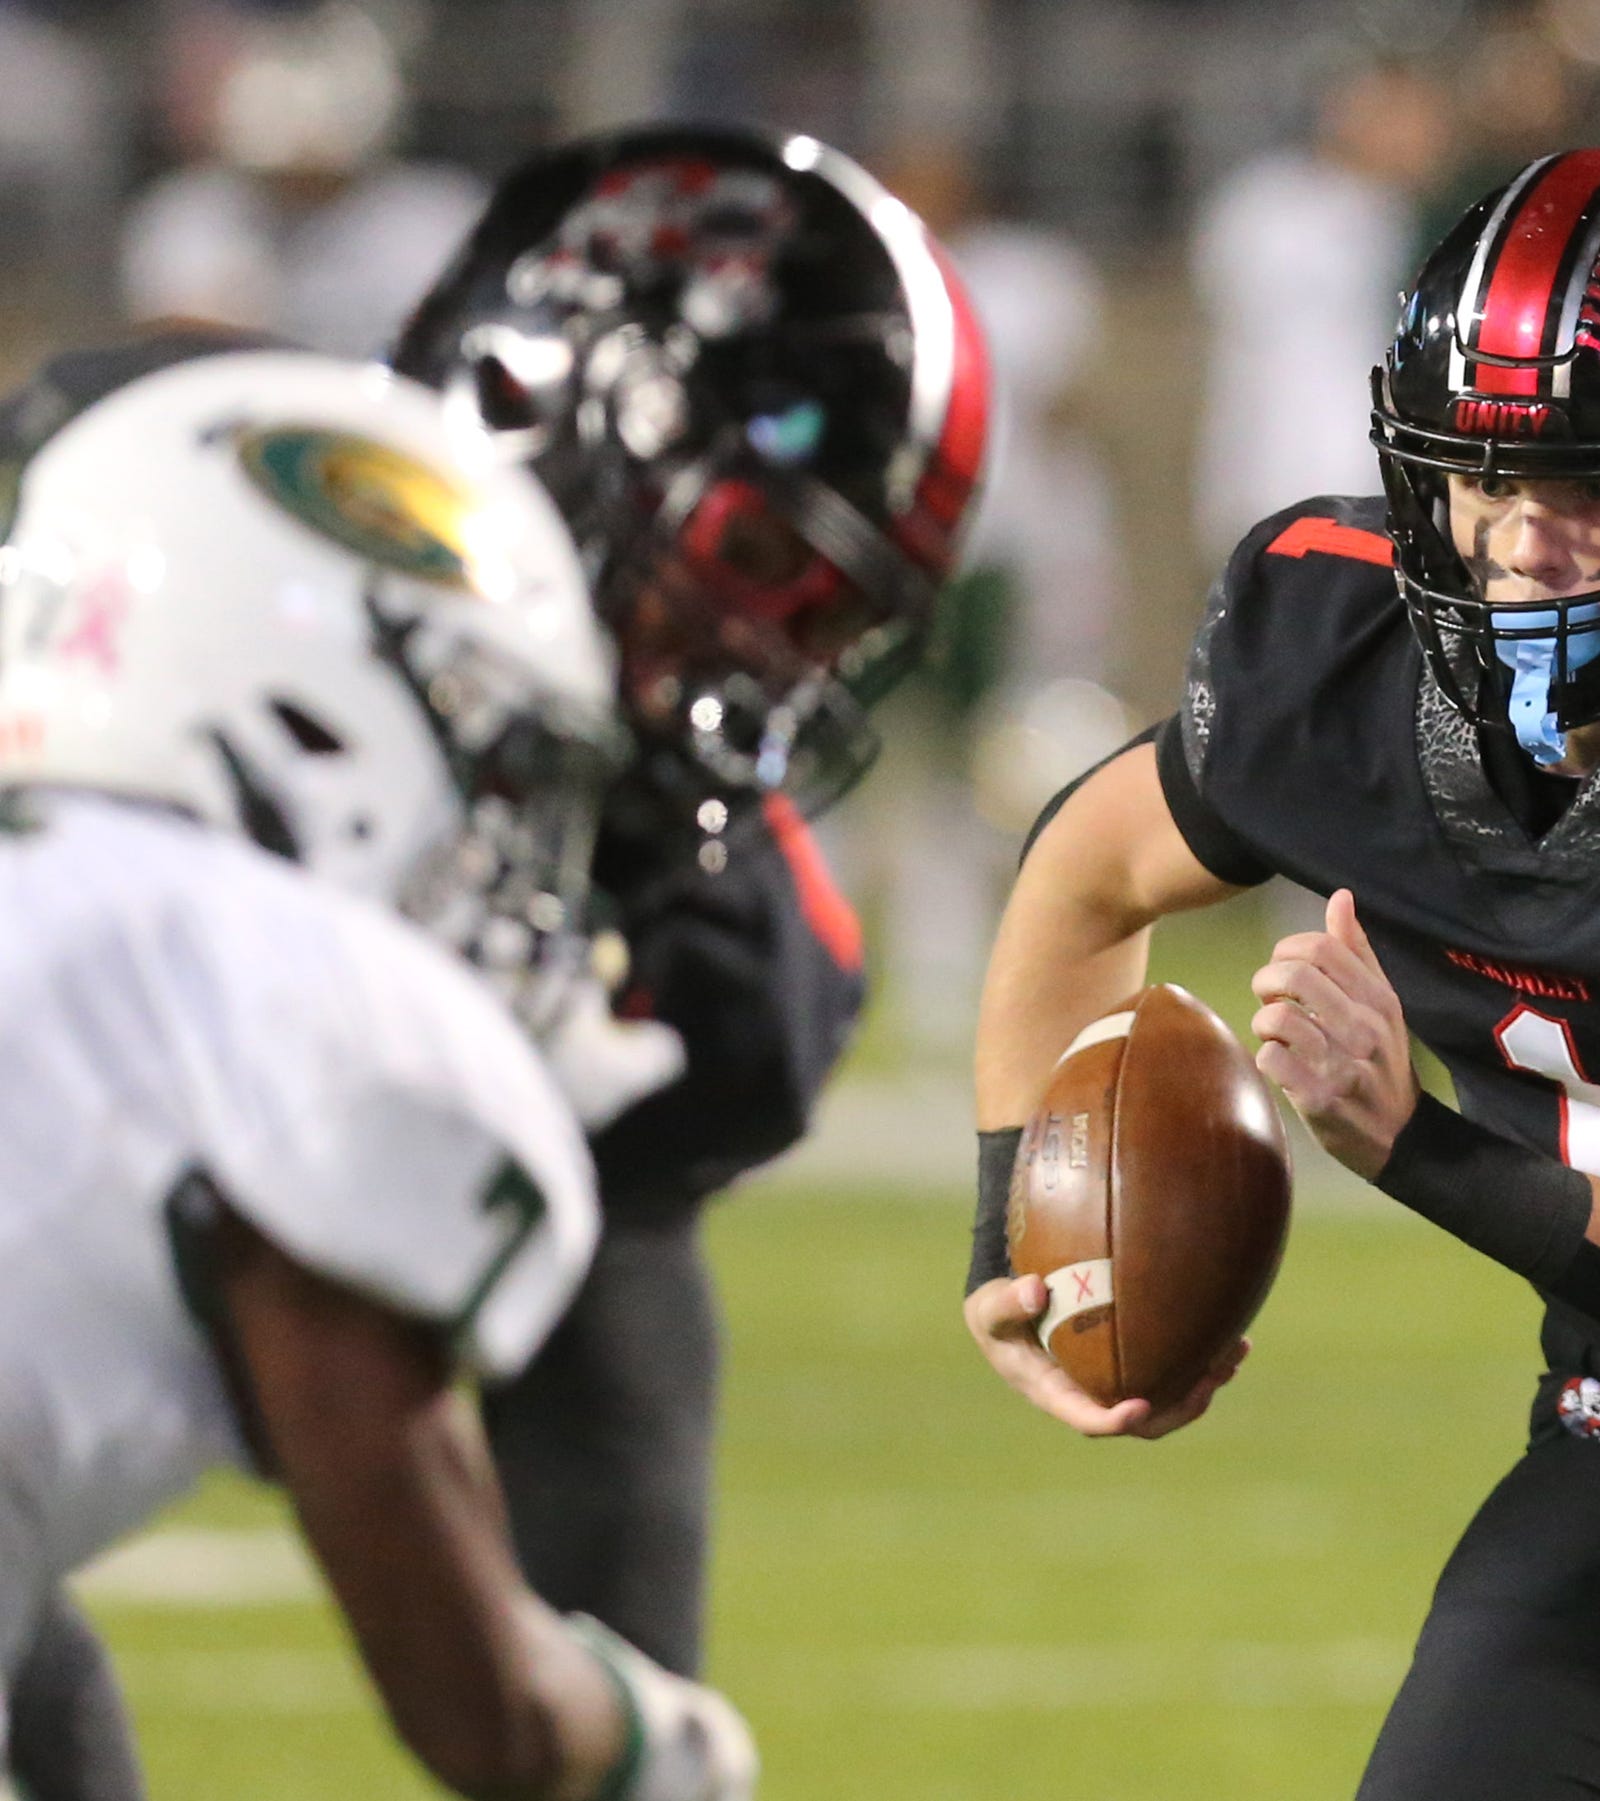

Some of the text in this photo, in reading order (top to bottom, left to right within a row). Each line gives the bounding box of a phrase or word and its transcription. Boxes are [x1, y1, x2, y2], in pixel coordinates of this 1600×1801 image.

[1455, 400, 1550, 436] UNITY
[1266, 516, 1396, 569] 1
[1072, 1269, 1095, 1303] X
